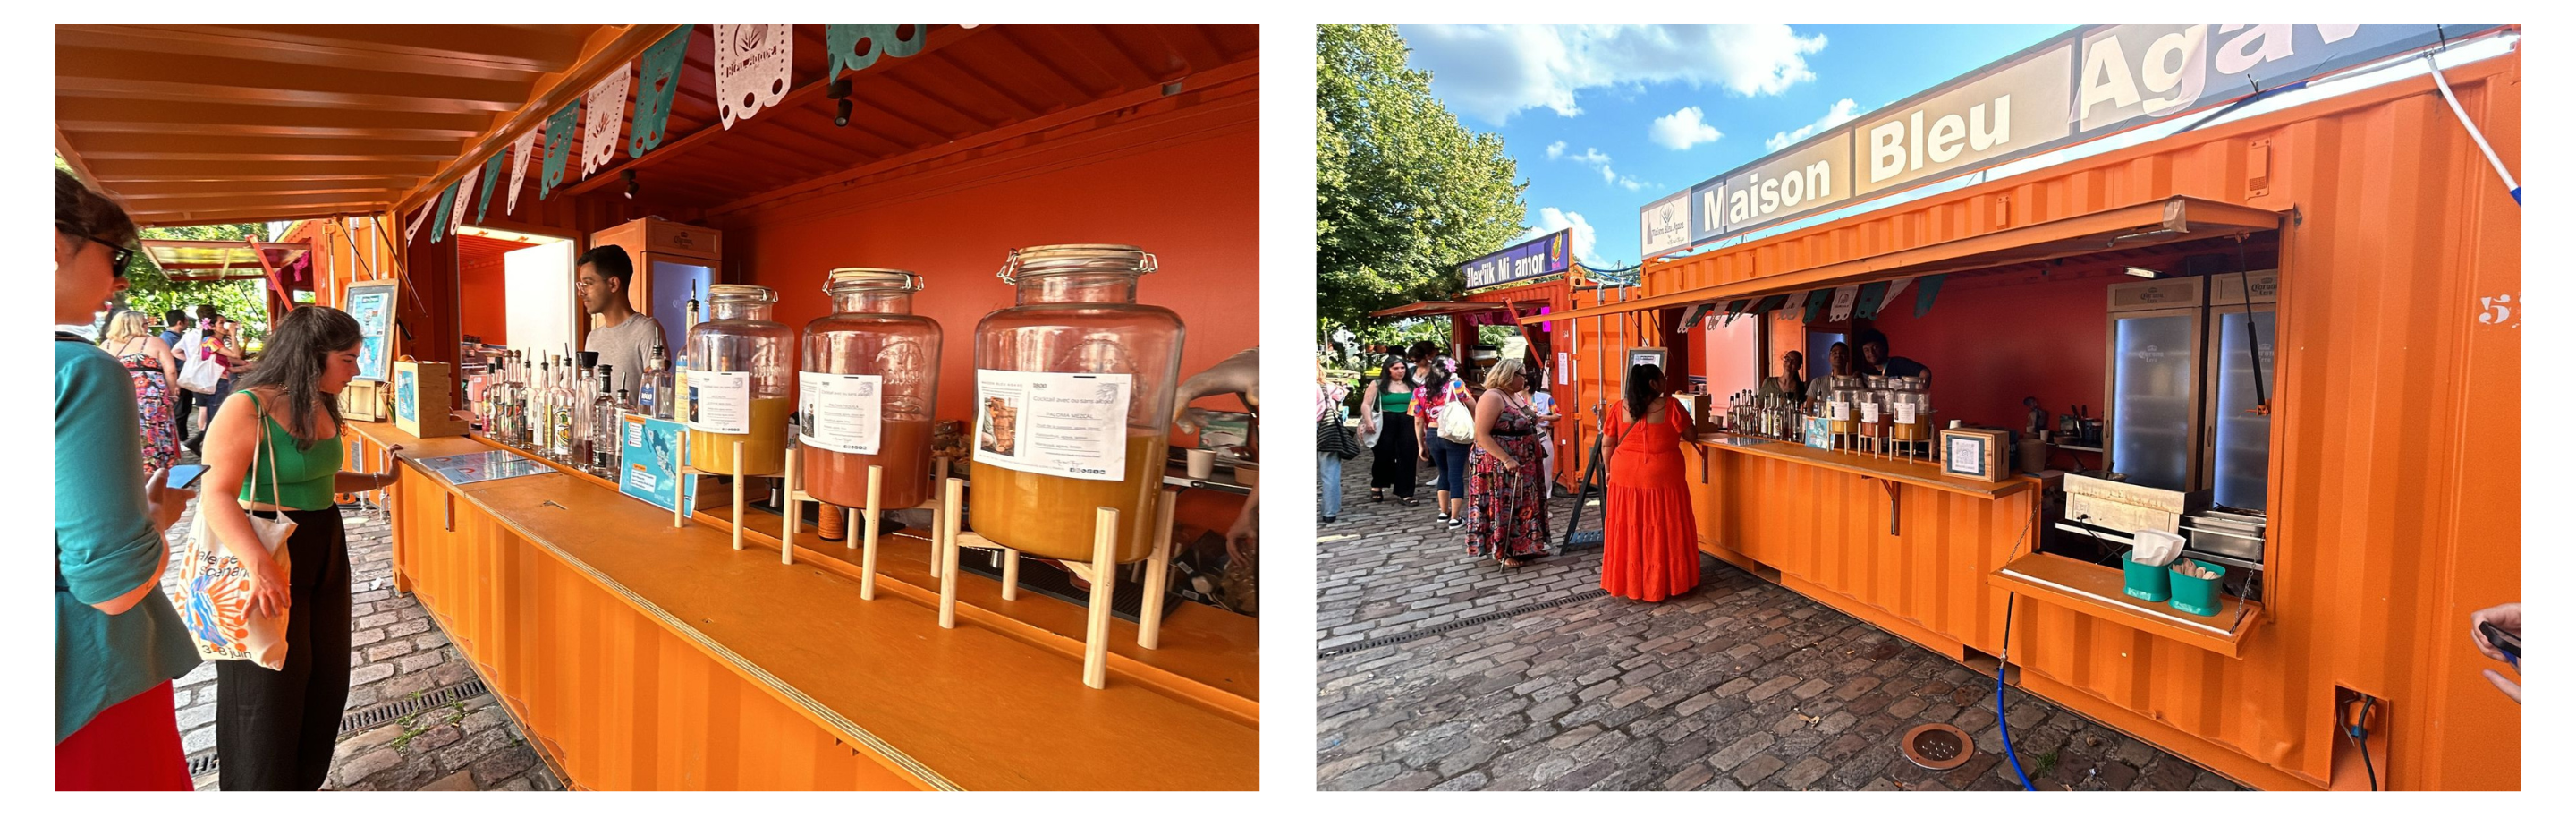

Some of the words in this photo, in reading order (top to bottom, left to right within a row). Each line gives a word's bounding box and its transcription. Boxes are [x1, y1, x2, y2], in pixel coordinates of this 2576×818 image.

[1703, 159, 1831, 233] Maison
[1869, 94, 2011, 183] Bleu
[2080, 24, 2360, 118] Aga
[1498, 256, 1510, 282] Mi
[1514, 252, 1546, 277] amor
